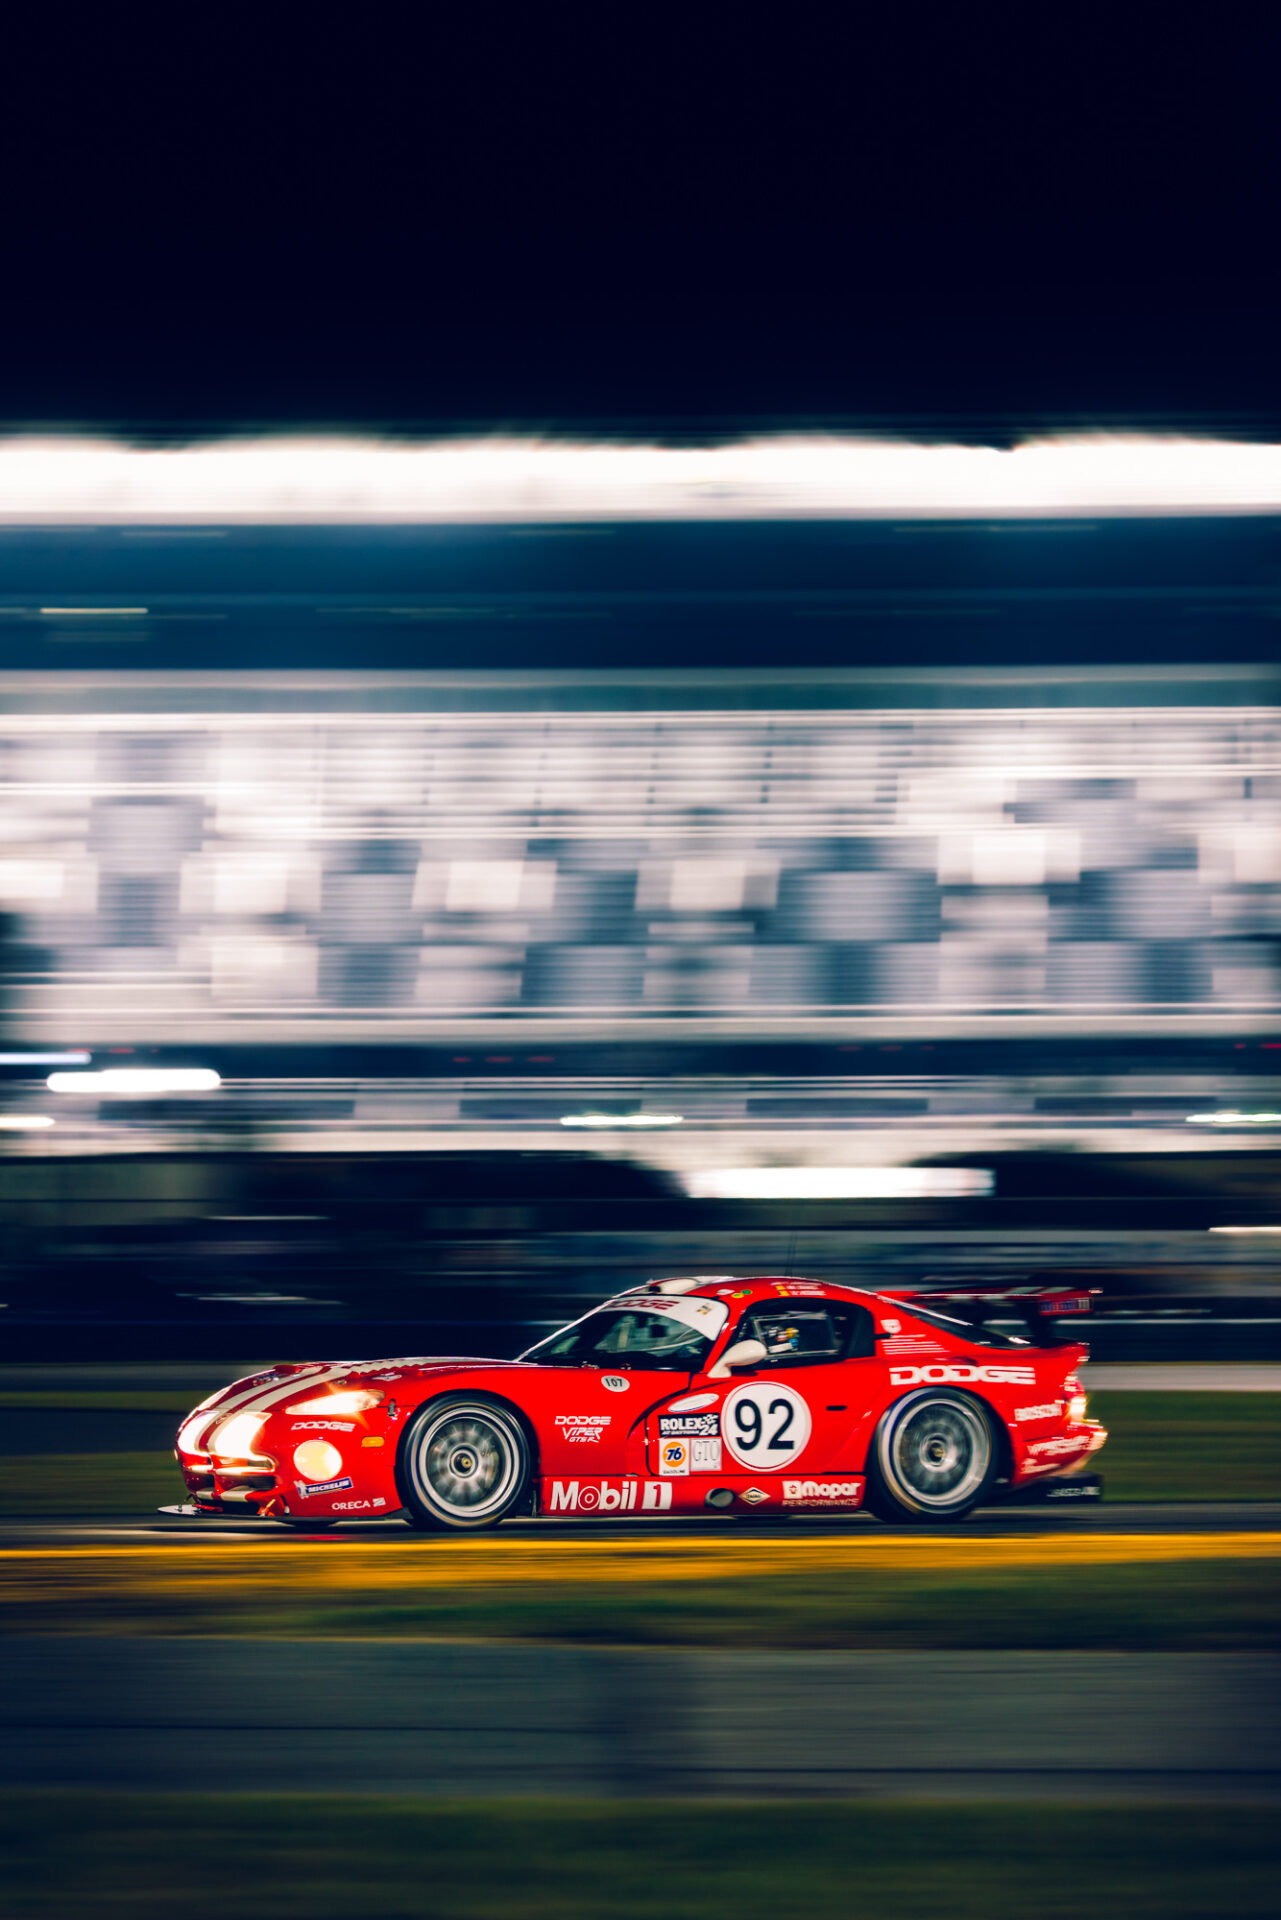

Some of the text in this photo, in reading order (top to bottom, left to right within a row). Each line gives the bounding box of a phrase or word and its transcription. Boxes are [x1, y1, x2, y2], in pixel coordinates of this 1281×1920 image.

[889, 1365, 1036, 1385] DODGE
[605, 1378, 623, 1387] 107
[291, 1421, 355, 1432] DODGE
[554, 1416, 612, 1425] DODGE
[660, 1417, 718, 1436] ROLEX 24
[735, 1398, 795, 1451] 92
[562, 1427, 604, 1440] VIPER
[667, 1447, 682, 1460] 76
[307, 1480, 350, 1494] MICHELIN
[801, 1481, 861, 1499] Mopar
[550, 1481, 637, 1510] Mobil
[331, 1500, 371, 1510] ORECA
[782, 1498, 860, 1507] PERFORMANCE
